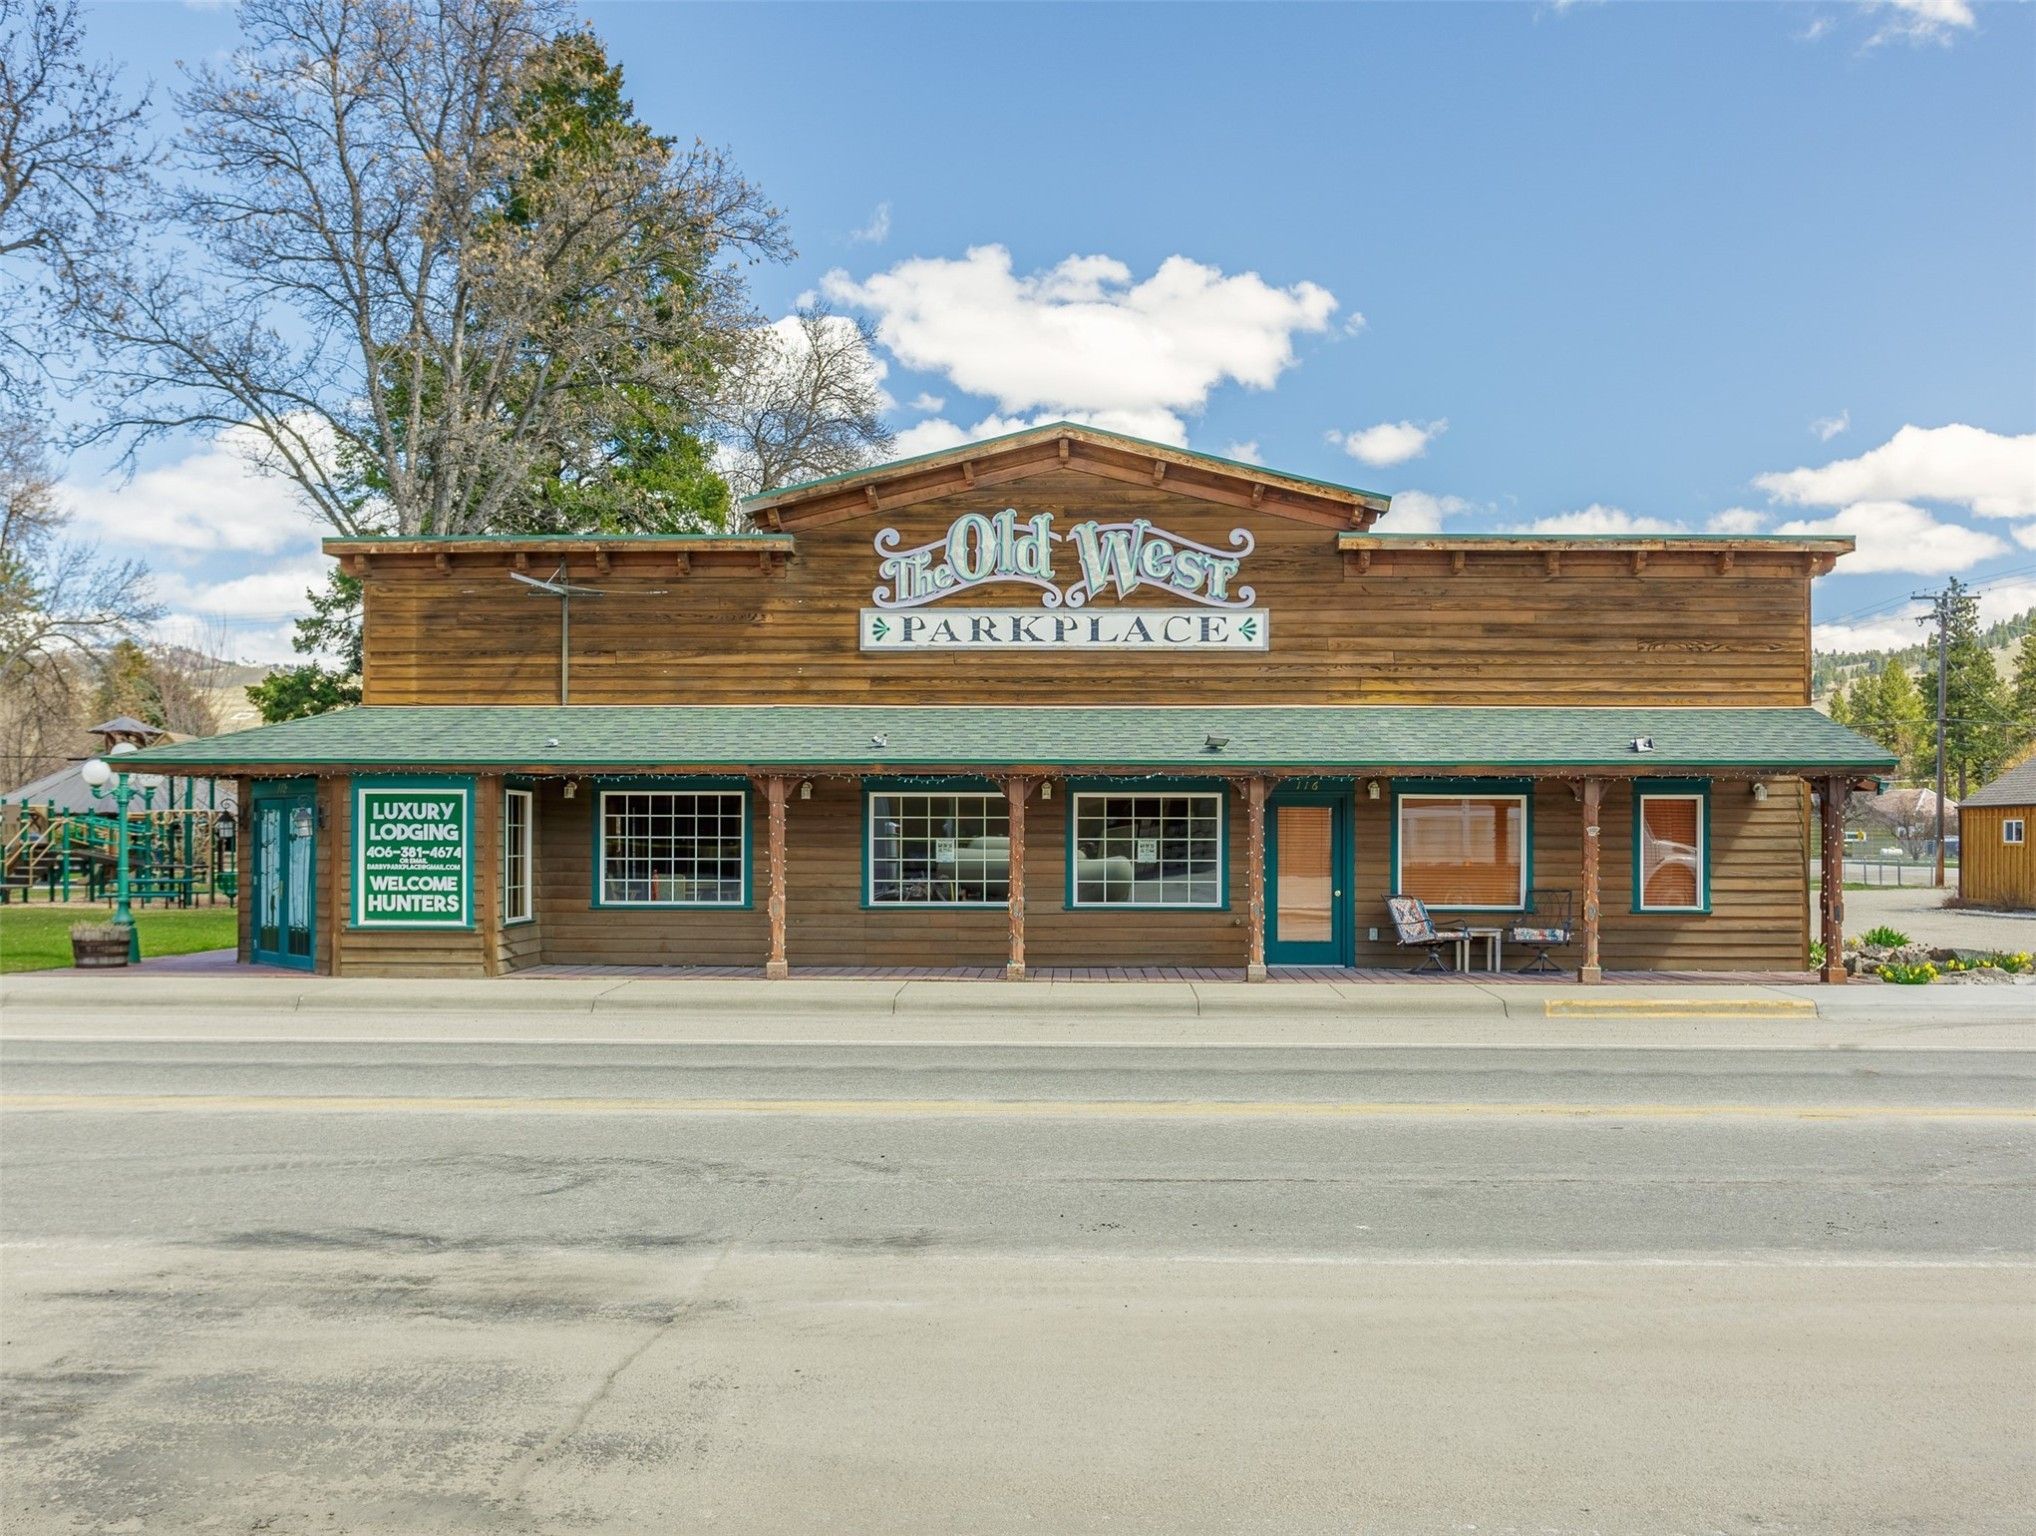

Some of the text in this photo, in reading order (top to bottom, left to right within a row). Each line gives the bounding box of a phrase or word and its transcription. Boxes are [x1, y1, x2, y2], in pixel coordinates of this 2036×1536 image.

[880, 508, 1240, 602] The Old West
[900, 615, 1229, 643] PARKPLACE
[373, 802, 455, 820] LUXURY
[370, 823, 459, 841] LODGING
[366, 846, 462, 858] 406-381-4674
[369, 876, 458, 891] WELCOME
[368, 895, 460, 912] HUNTERS
